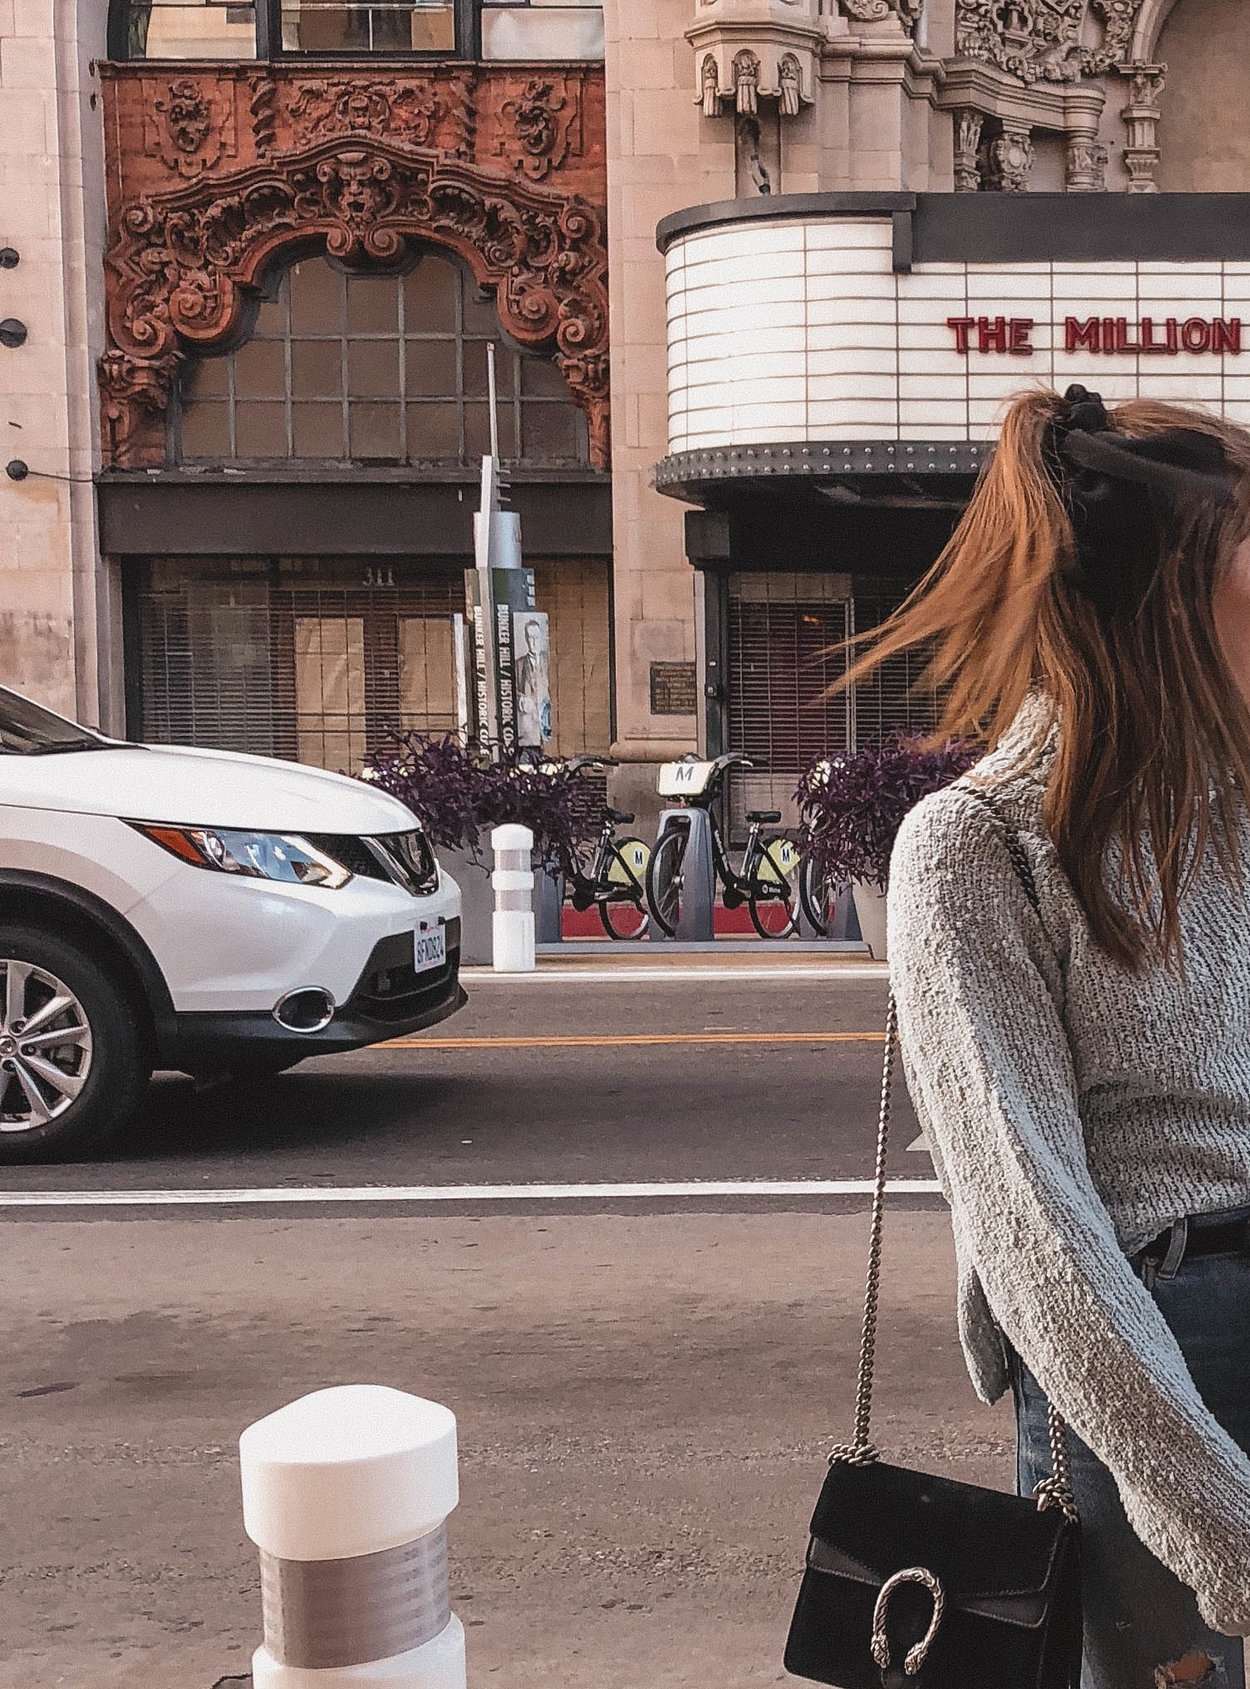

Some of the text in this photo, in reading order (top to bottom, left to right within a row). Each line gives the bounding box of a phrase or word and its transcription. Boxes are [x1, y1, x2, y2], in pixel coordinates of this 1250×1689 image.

[948, 317, 1034, 354] THE
[1065, 316, 1241, 355] MILLION
[362, 567, 395, 587] 311
[473, 606, 484, 646] BUNKER
[497, 604, 510, 644] BUNKER
[475, 648, 487, 669] HILL
[498, 647, 511, 668] HILL
[477, 680, 489, 727] HISTORIC
[500, 679, 513, 725] HISTORIC
[675, 765, 695, 781] M
[634, 851, 643, 865] M
[782, 849, 791, 862] M
